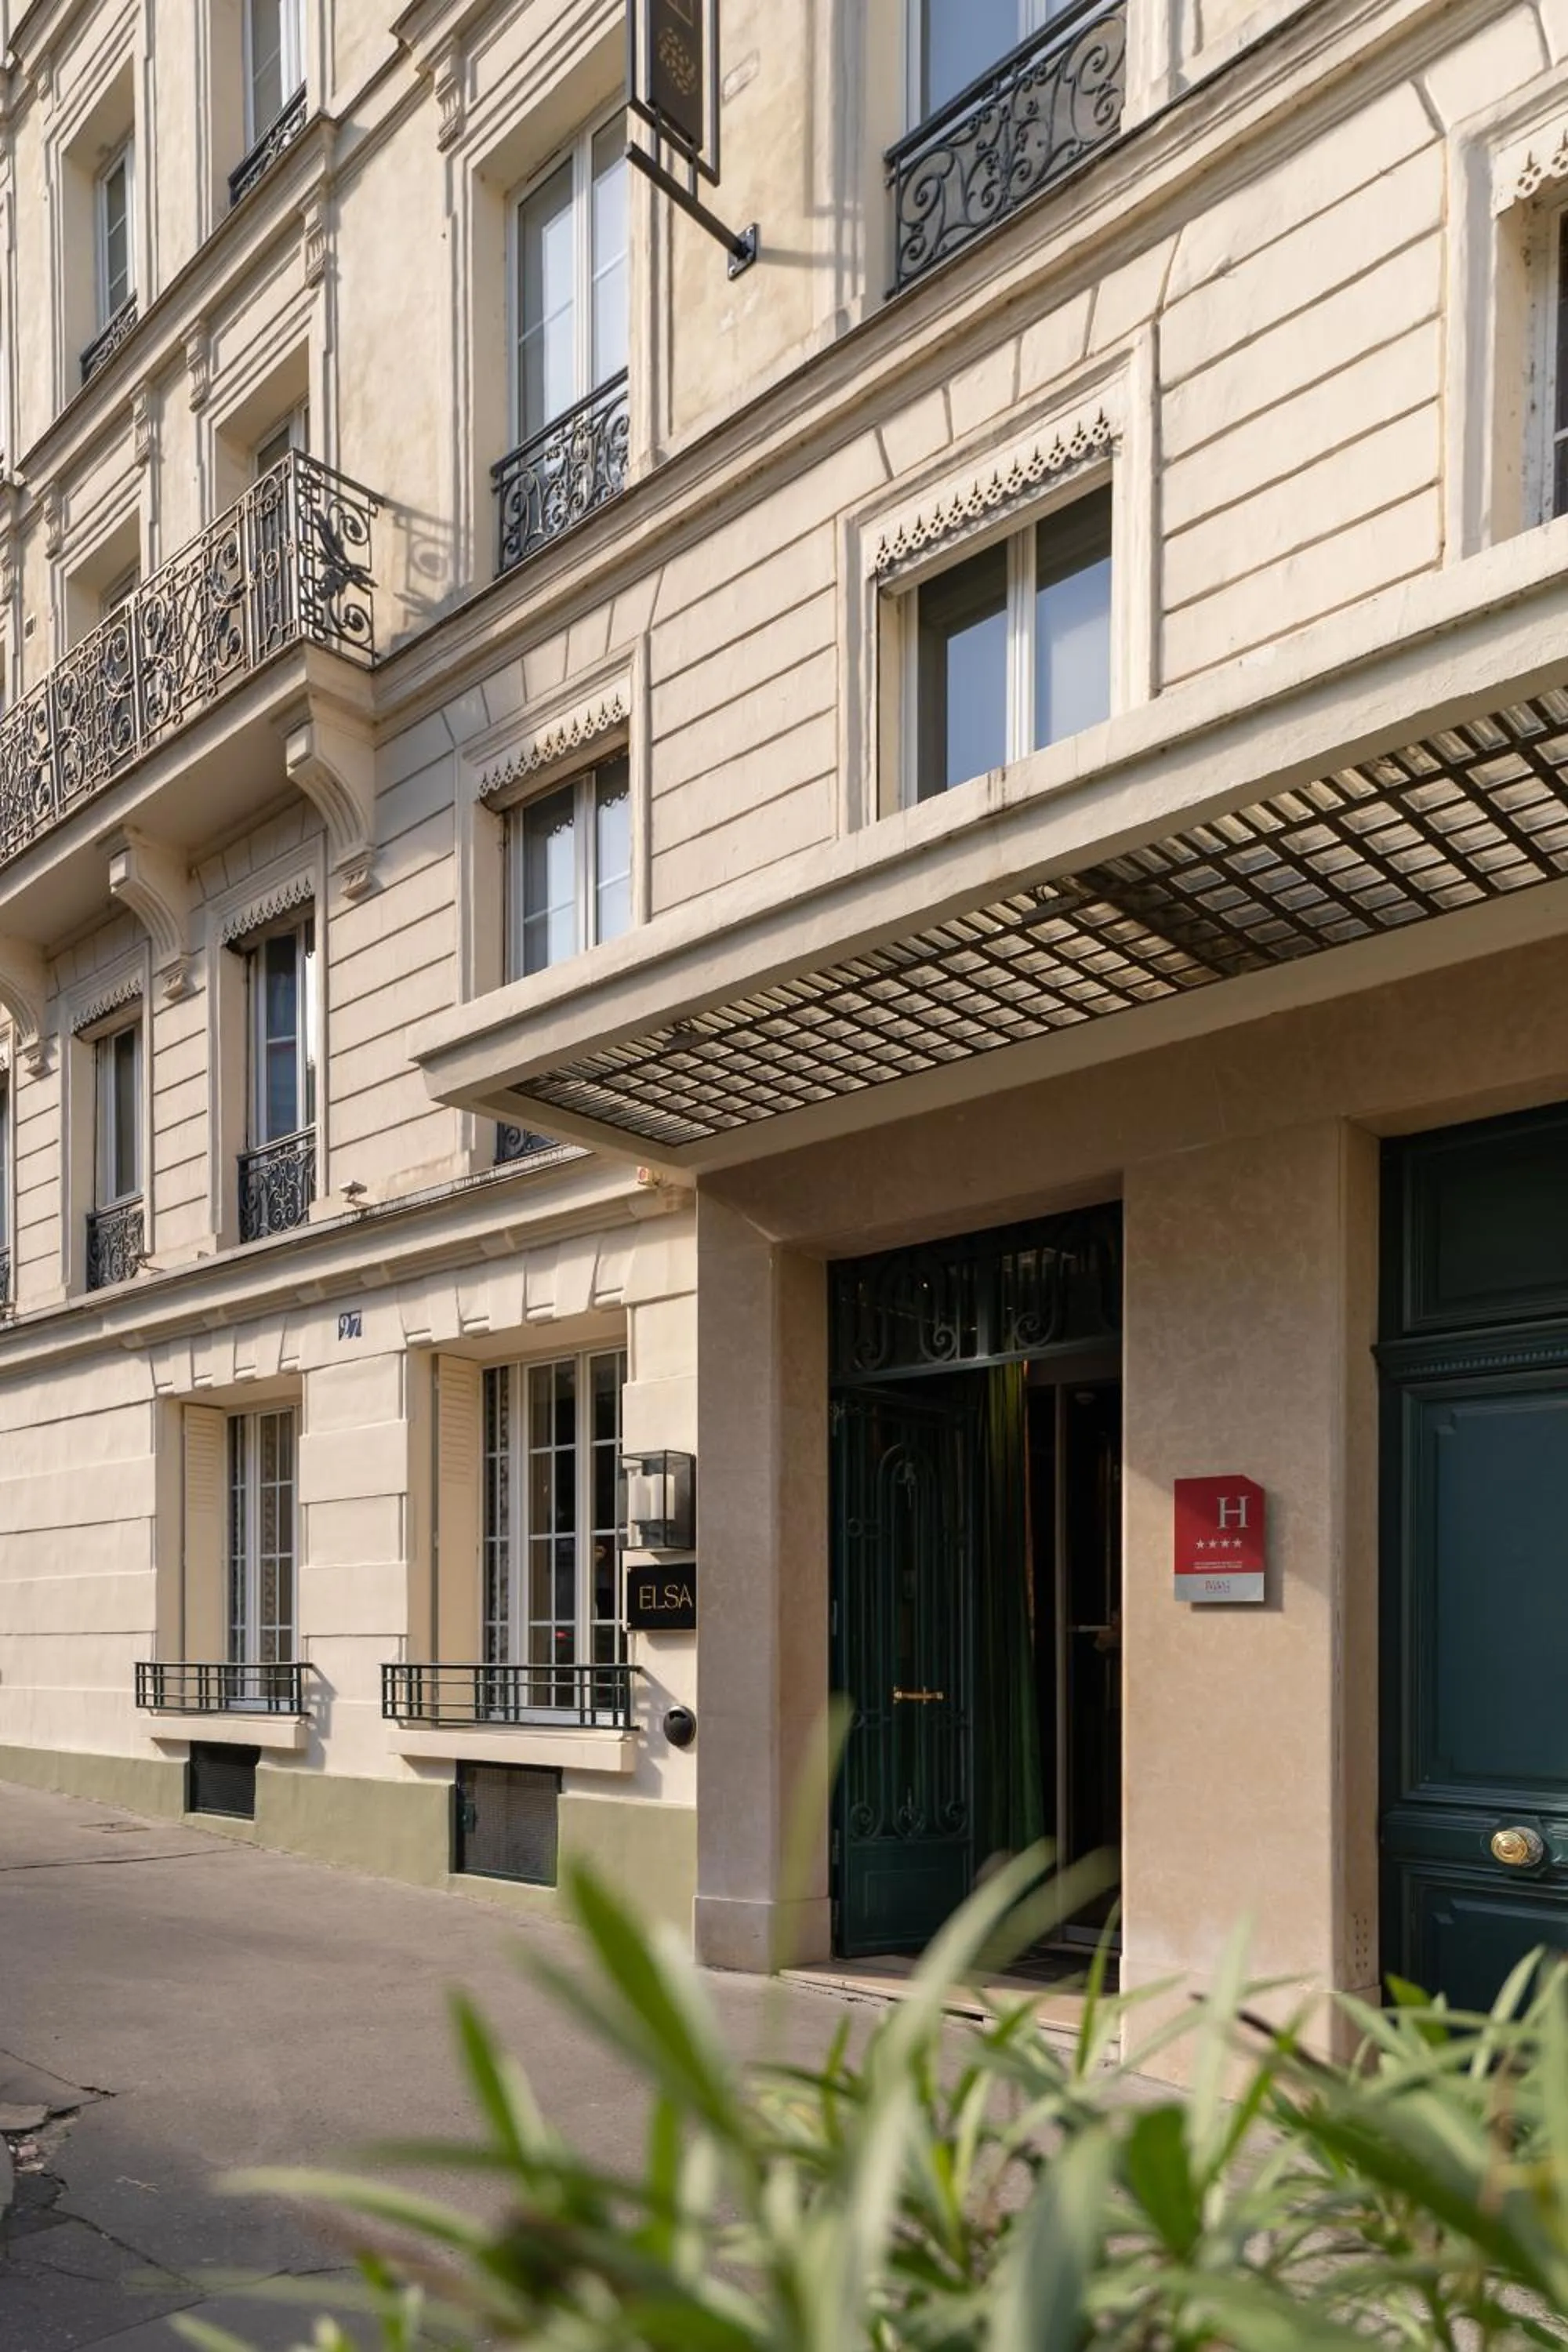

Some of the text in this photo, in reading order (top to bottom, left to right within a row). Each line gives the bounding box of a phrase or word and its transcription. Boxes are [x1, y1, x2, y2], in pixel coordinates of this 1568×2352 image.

[339, 1312, 360, 1339] 97
[1217, 1495, 1250, 1529] H
[639, 1583, 692, 1610] ELSA
